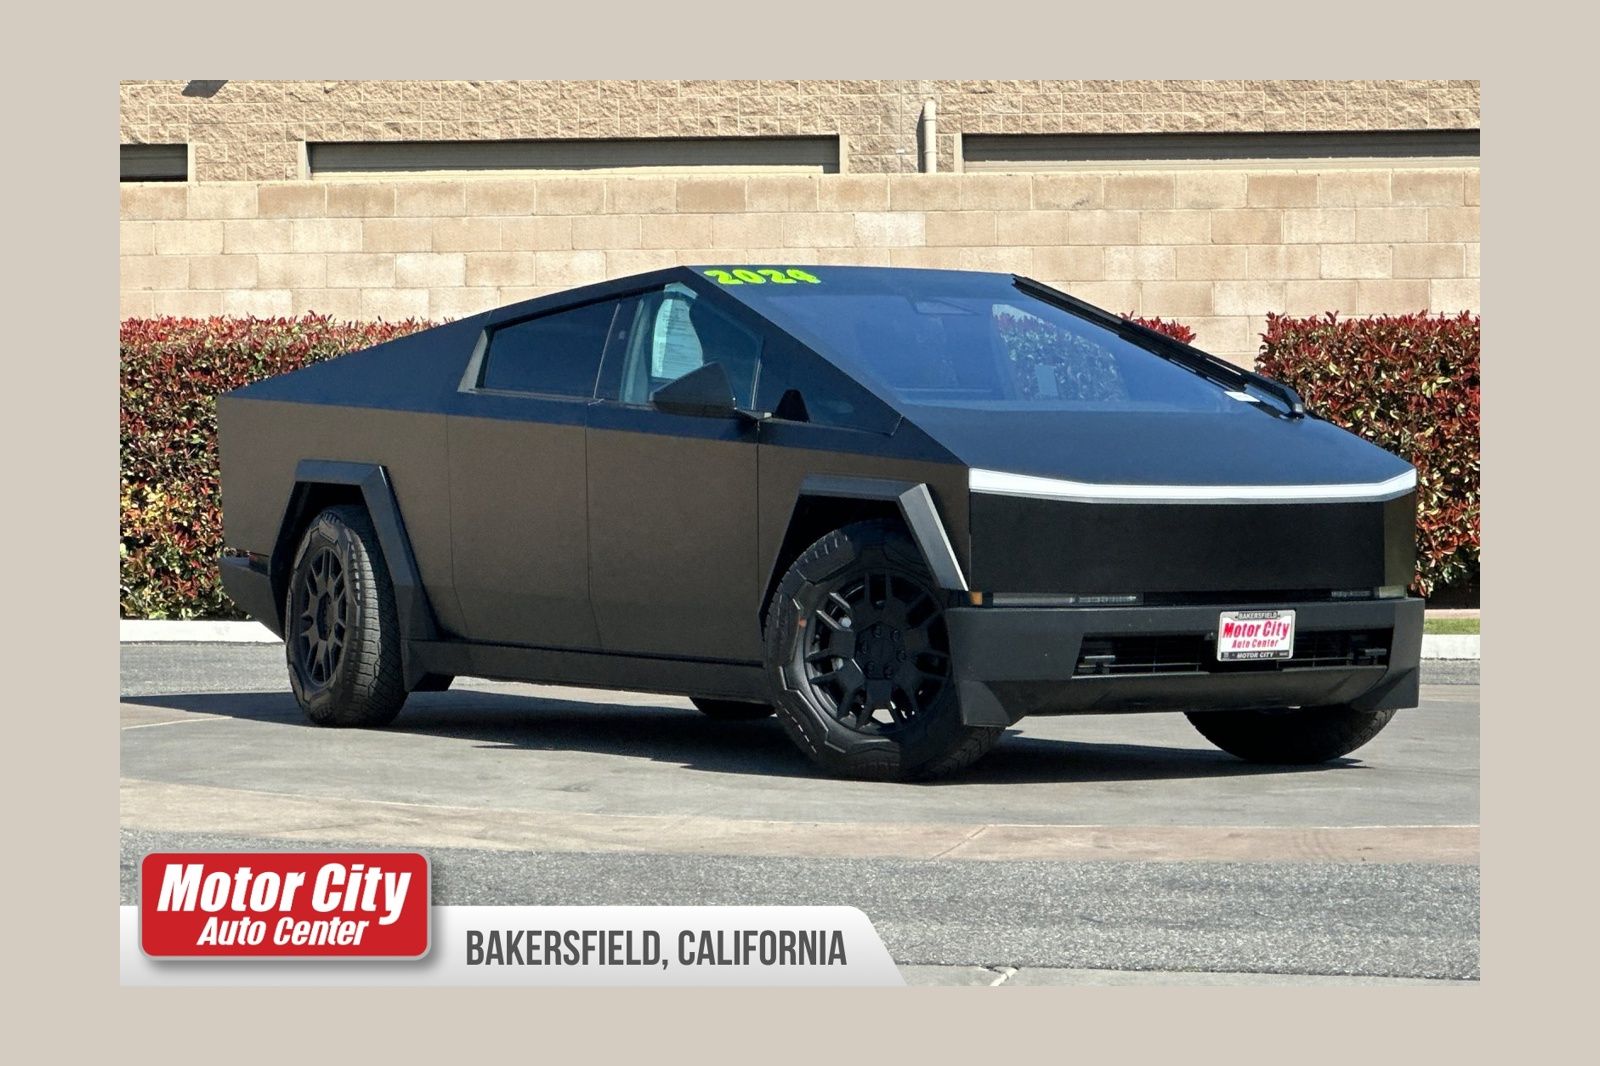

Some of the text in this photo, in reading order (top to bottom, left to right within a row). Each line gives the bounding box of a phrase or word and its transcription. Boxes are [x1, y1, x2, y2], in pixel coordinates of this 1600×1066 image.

[703, 269, 821, 284] 2024
[1222, 621, 1290, 640] Motor City
[1231, 639, 1279, 648] Auto Center
